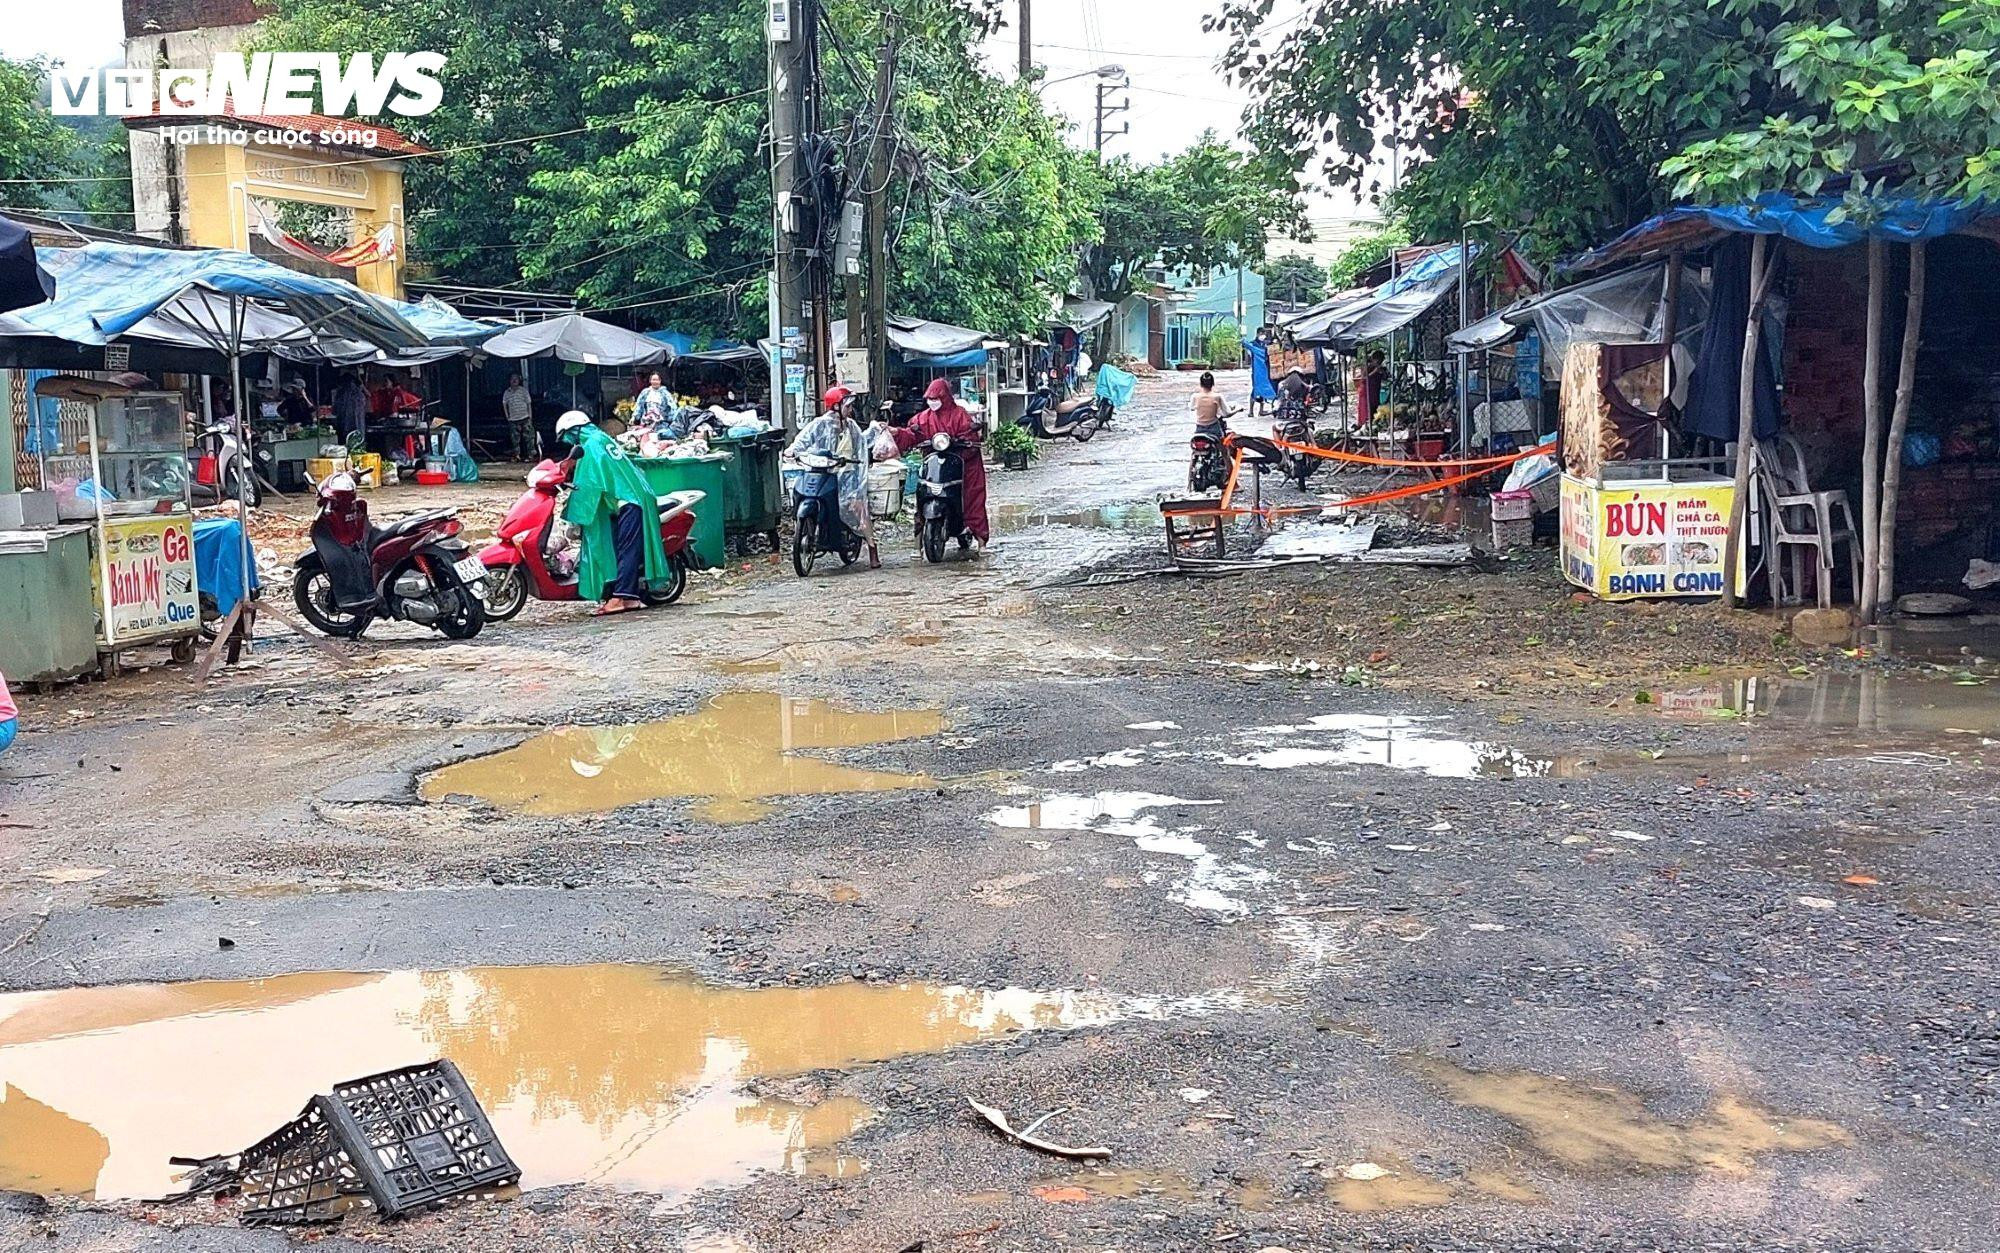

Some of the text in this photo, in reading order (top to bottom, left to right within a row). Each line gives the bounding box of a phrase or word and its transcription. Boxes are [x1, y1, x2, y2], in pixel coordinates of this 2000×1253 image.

[1606, 493, 1667, 537] BÚN
[1704, 513, 1721, 522] CÁ
[163, 525, 190, 563] Gà
[110, 560, 142, 607] Bánh
[1609, 570, 1666, 594] BÁNH
[167, 602, 195, 624] Que
